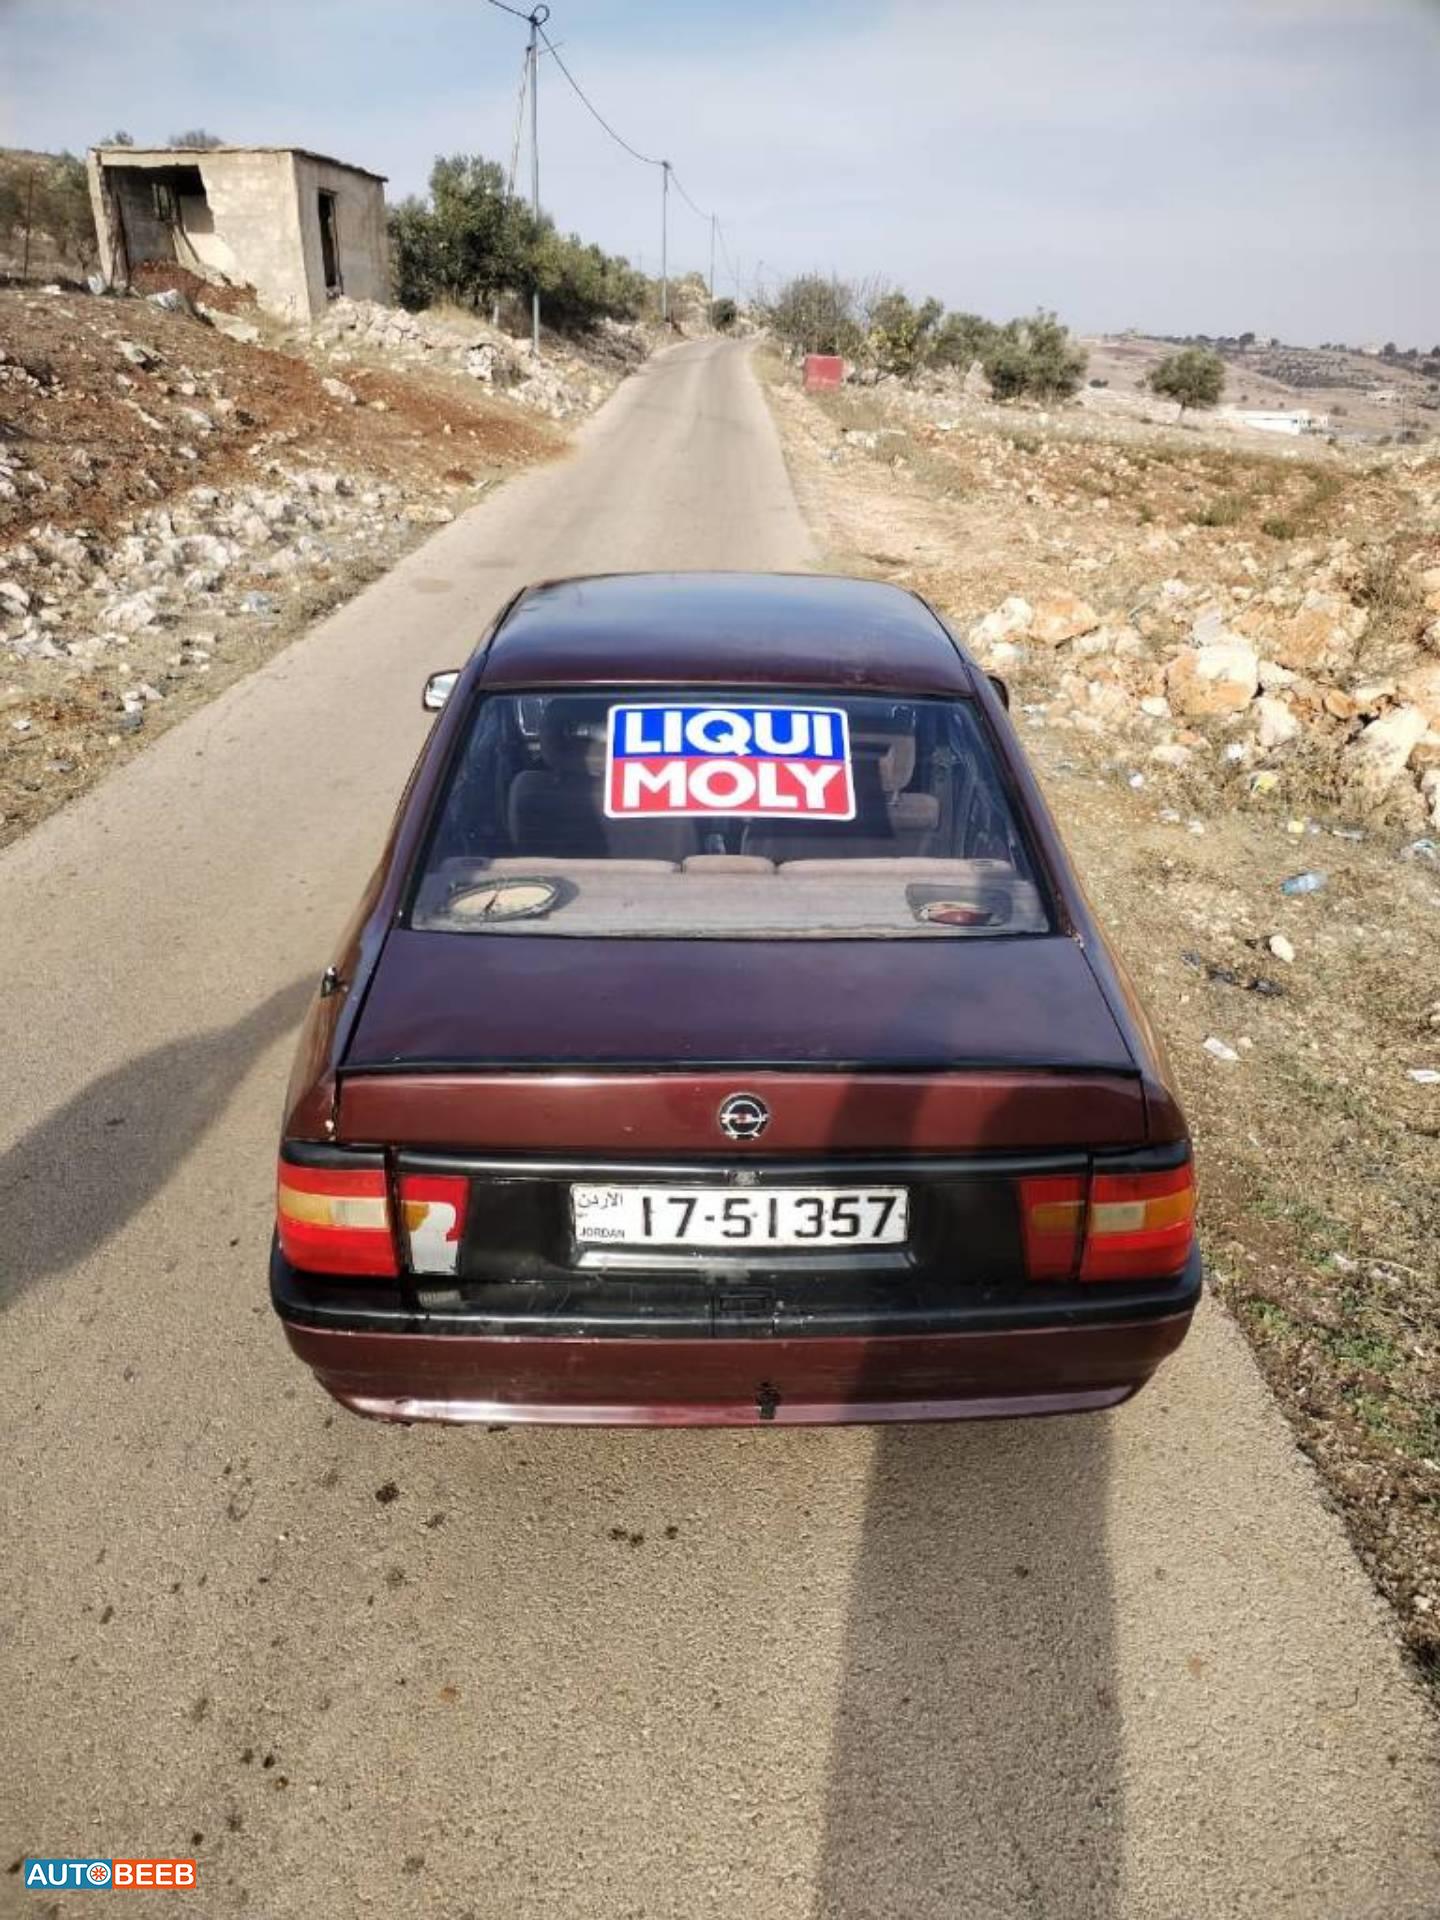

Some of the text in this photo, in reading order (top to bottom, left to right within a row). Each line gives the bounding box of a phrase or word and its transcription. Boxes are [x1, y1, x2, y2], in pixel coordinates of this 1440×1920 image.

[624, 710, 833, 756] LIQUI
[623, 760, 843, 809] MOLY
[579, 1227, 625, 1239] JORDAN
[642, 1196, 898, 1238] 17-51357
